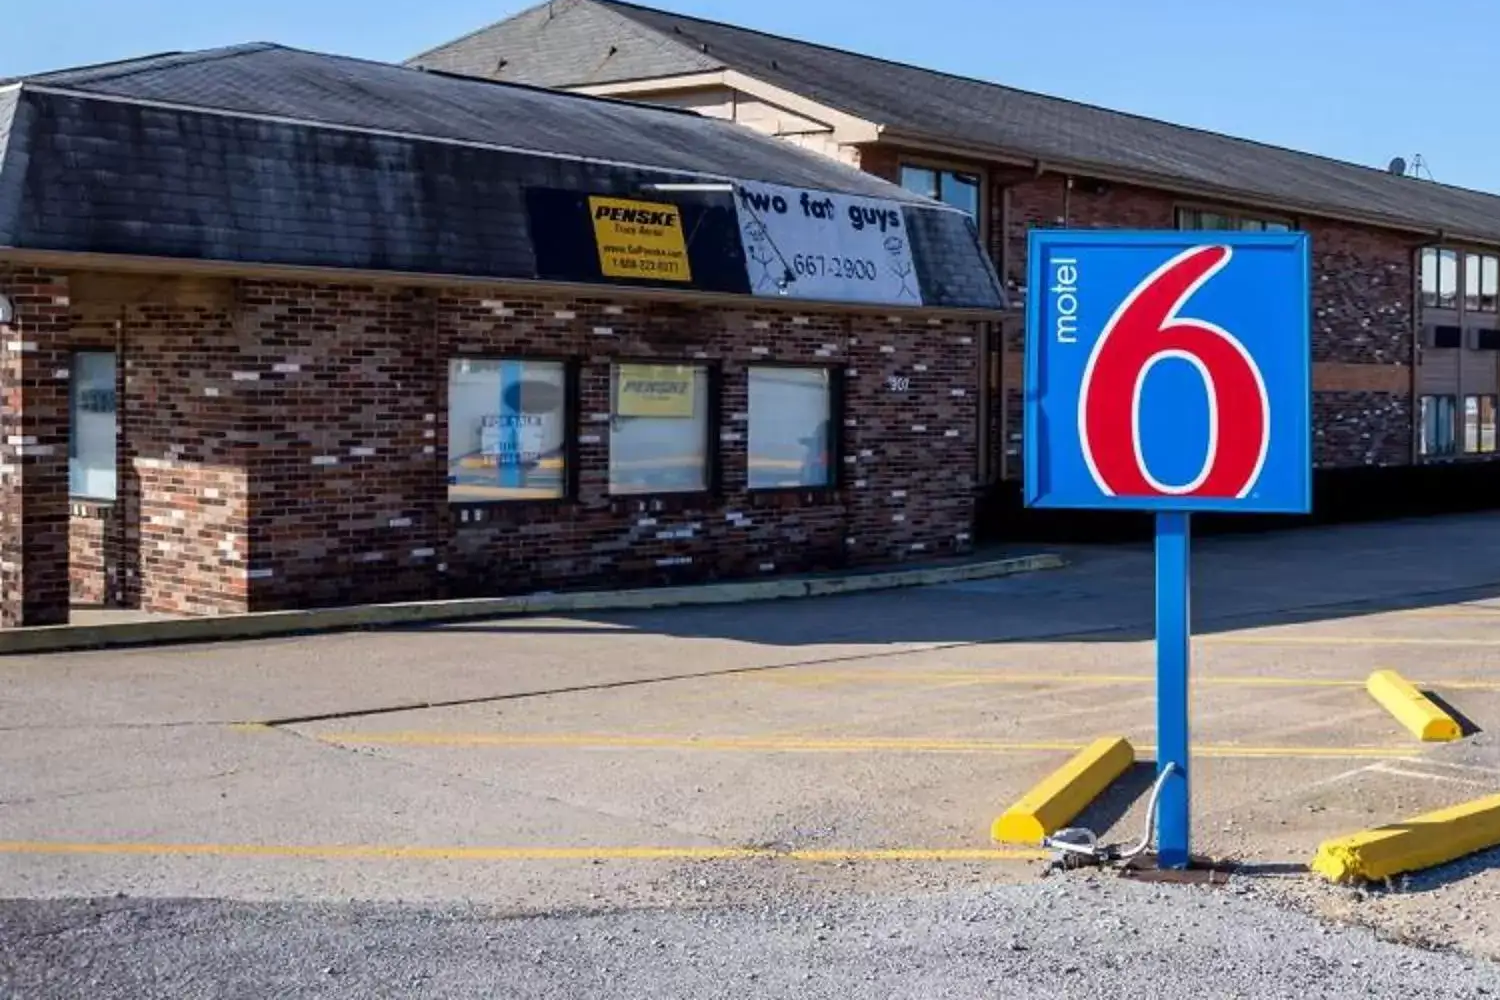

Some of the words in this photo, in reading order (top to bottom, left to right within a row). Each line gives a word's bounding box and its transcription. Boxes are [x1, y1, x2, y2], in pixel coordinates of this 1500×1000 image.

[595, 205, 679, 227] PENSKE
[738, 186, 788, 215] two
[800, 192, 835, 221] fat
[848, 204, 900, 233] guys
[793, 253, 877, 281] 667-2900
[1050, 258, 1078, 343] motel
[1077, 244, 1271, 499] 6
